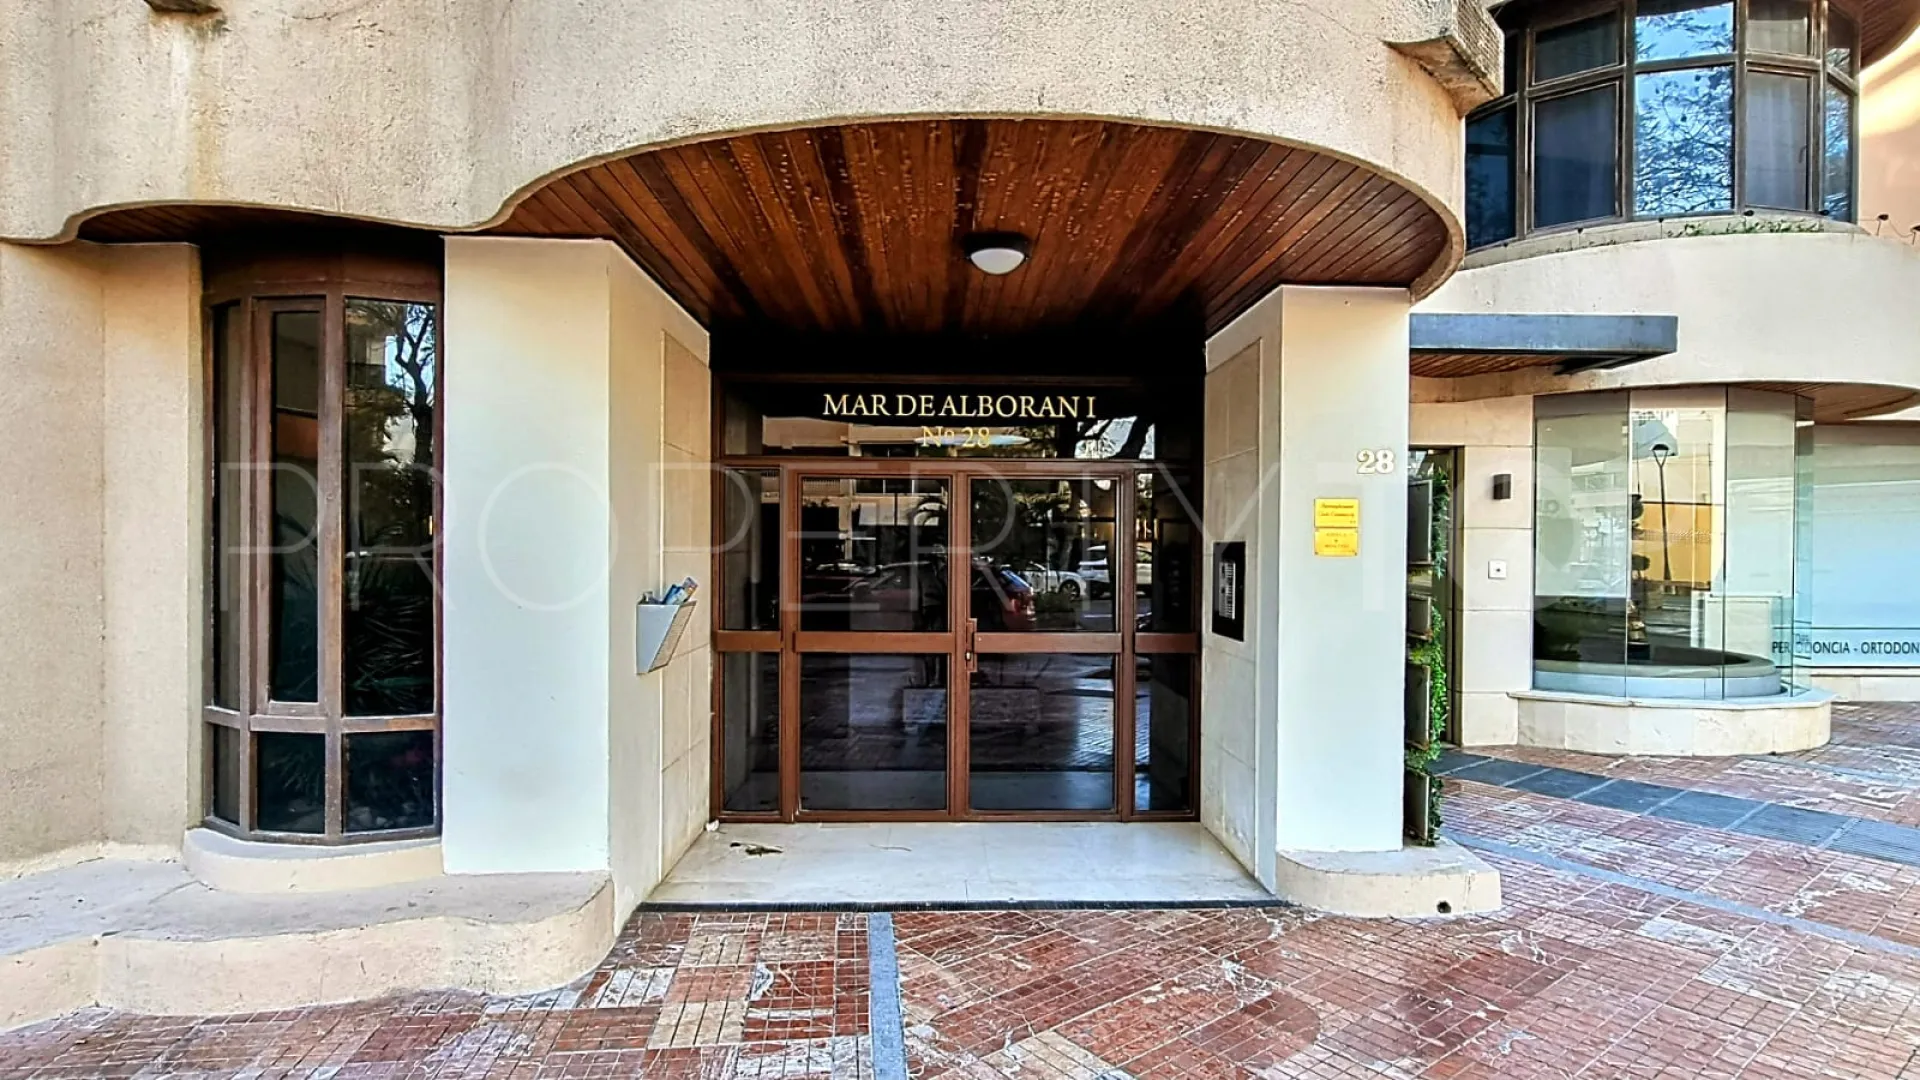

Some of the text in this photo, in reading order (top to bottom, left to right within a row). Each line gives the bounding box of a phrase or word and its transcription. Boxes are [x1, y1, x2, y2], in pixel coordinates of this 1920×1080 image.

[822, 394, 1097, 418] MAR DE ALBORAN I
[961, 427, 990, 447] 28
[1356, 449, 1395, 474] 28
[1772, 641, 1850, 654] PERODONCIA
